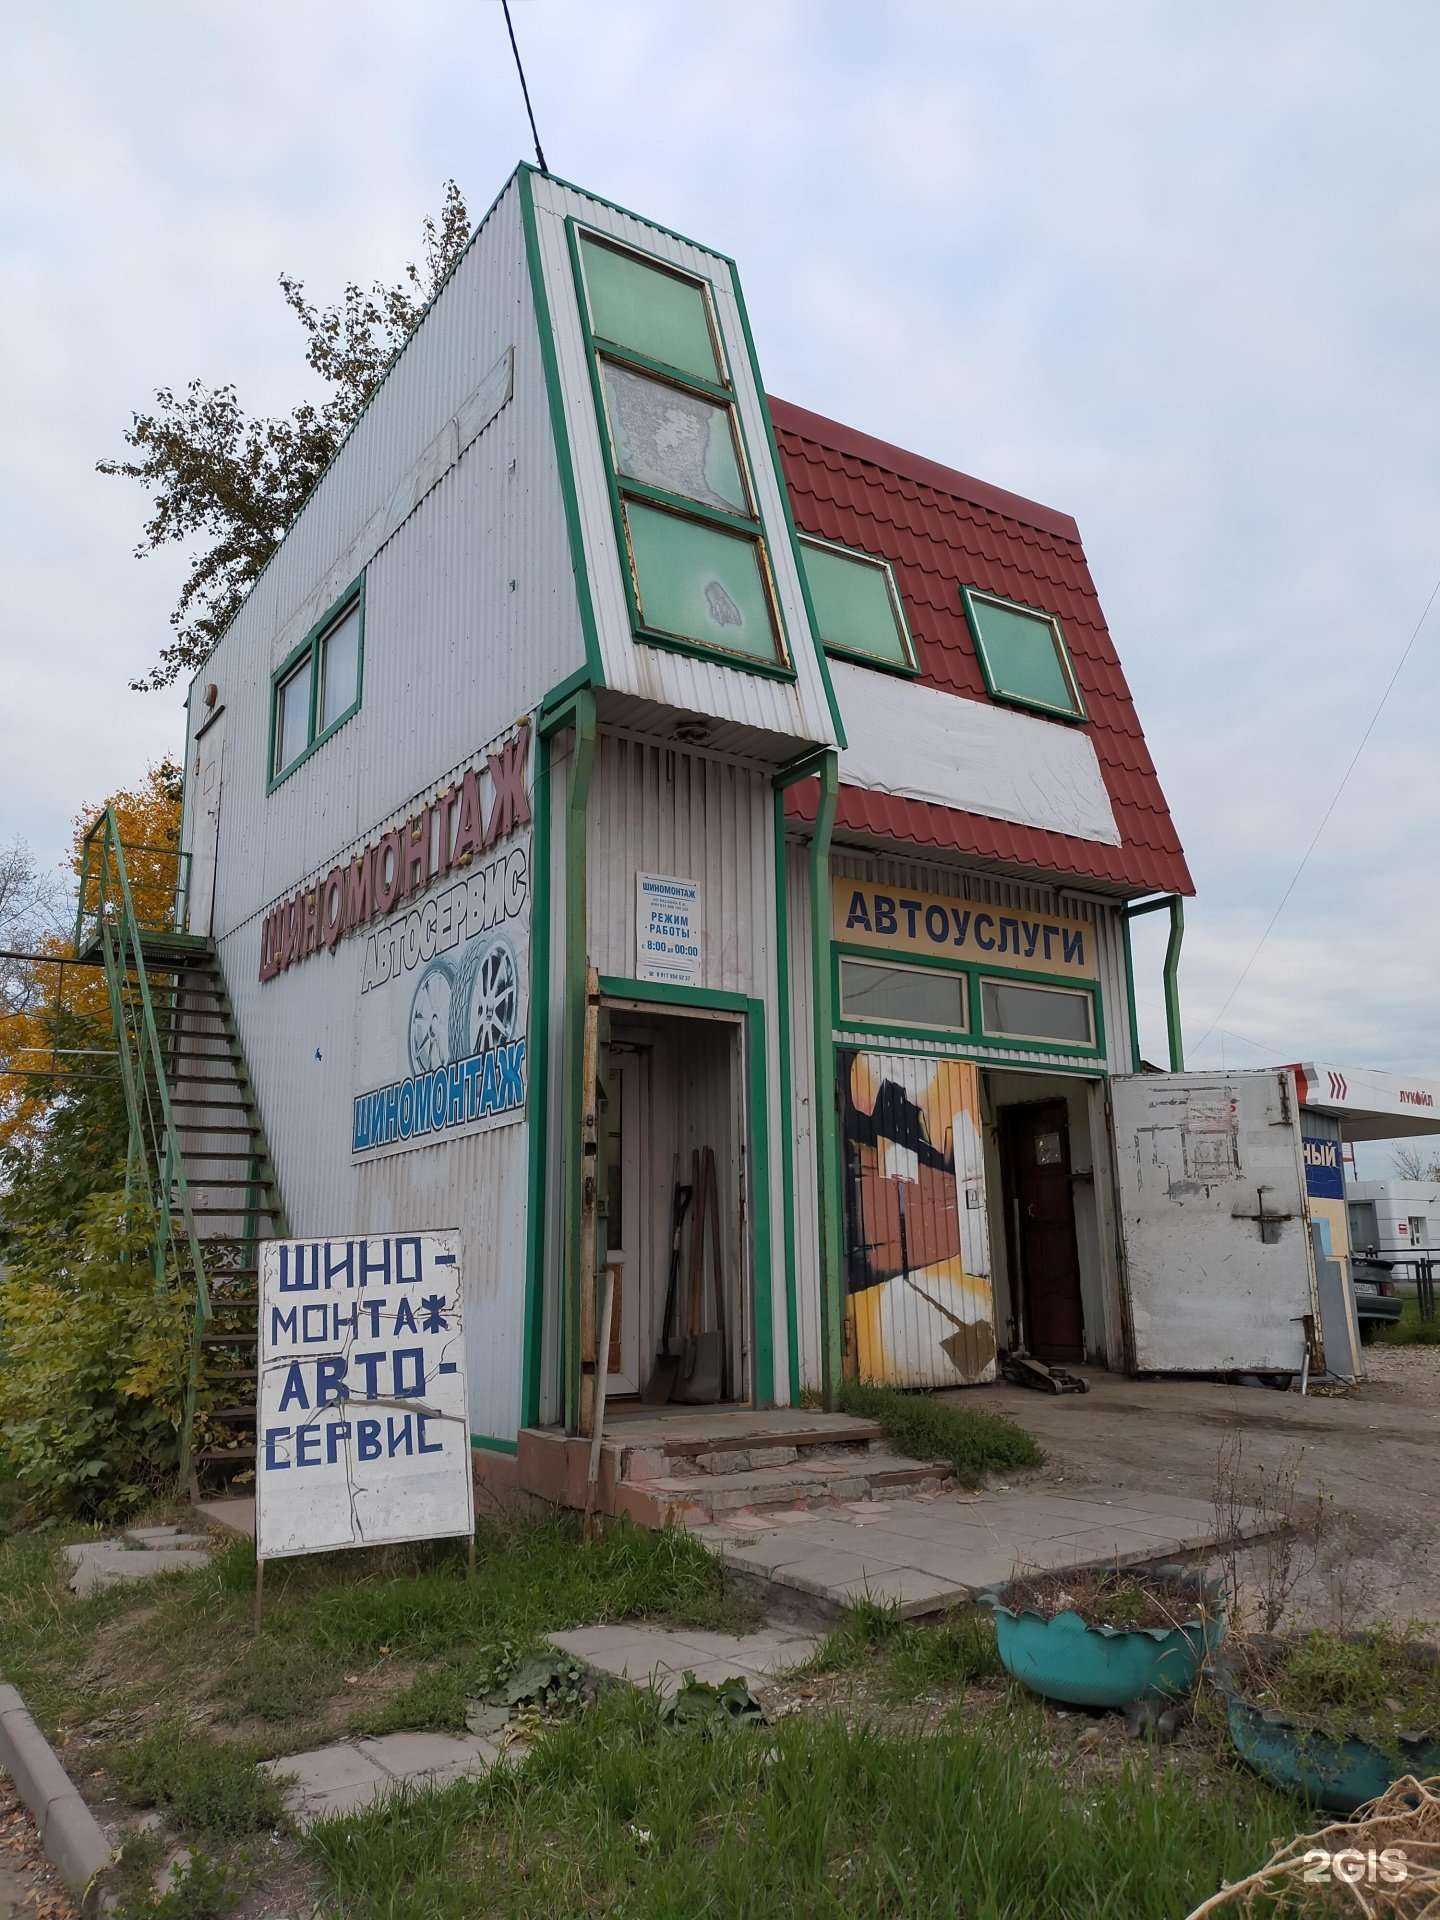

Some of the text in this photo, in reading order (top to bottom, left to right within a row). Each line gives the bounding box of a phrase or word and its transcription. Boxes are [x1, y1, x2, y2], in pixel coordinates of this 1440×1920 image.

[259, 726, 531, 984] ШИНОМОНТАЖ
[643, 882, 696, 899] ШИНОМОНТАЖ
[651, 912, 688, 926] РЕЖИМ
[361, 849, 527, 994] АВТОСЕРВИС
[647, 940, 666, 952] 8:00
[675, 944, 698, 957] 00:00
[650, 924, 690, 938] РАБОТЫ
[846, 891, 1085, 965] АВТОУСЛУГИ
[351, 1037, 527, 1154] ШИНОМОНТАЖ
[279, 1237, 457, 1292] ШИНО-
[271, 1295, 448, 1346] МОНТАЖ
[278, 1347, 457, 1412] АВТО-
[265, 1409, 443, 1471] СЕРВИС
